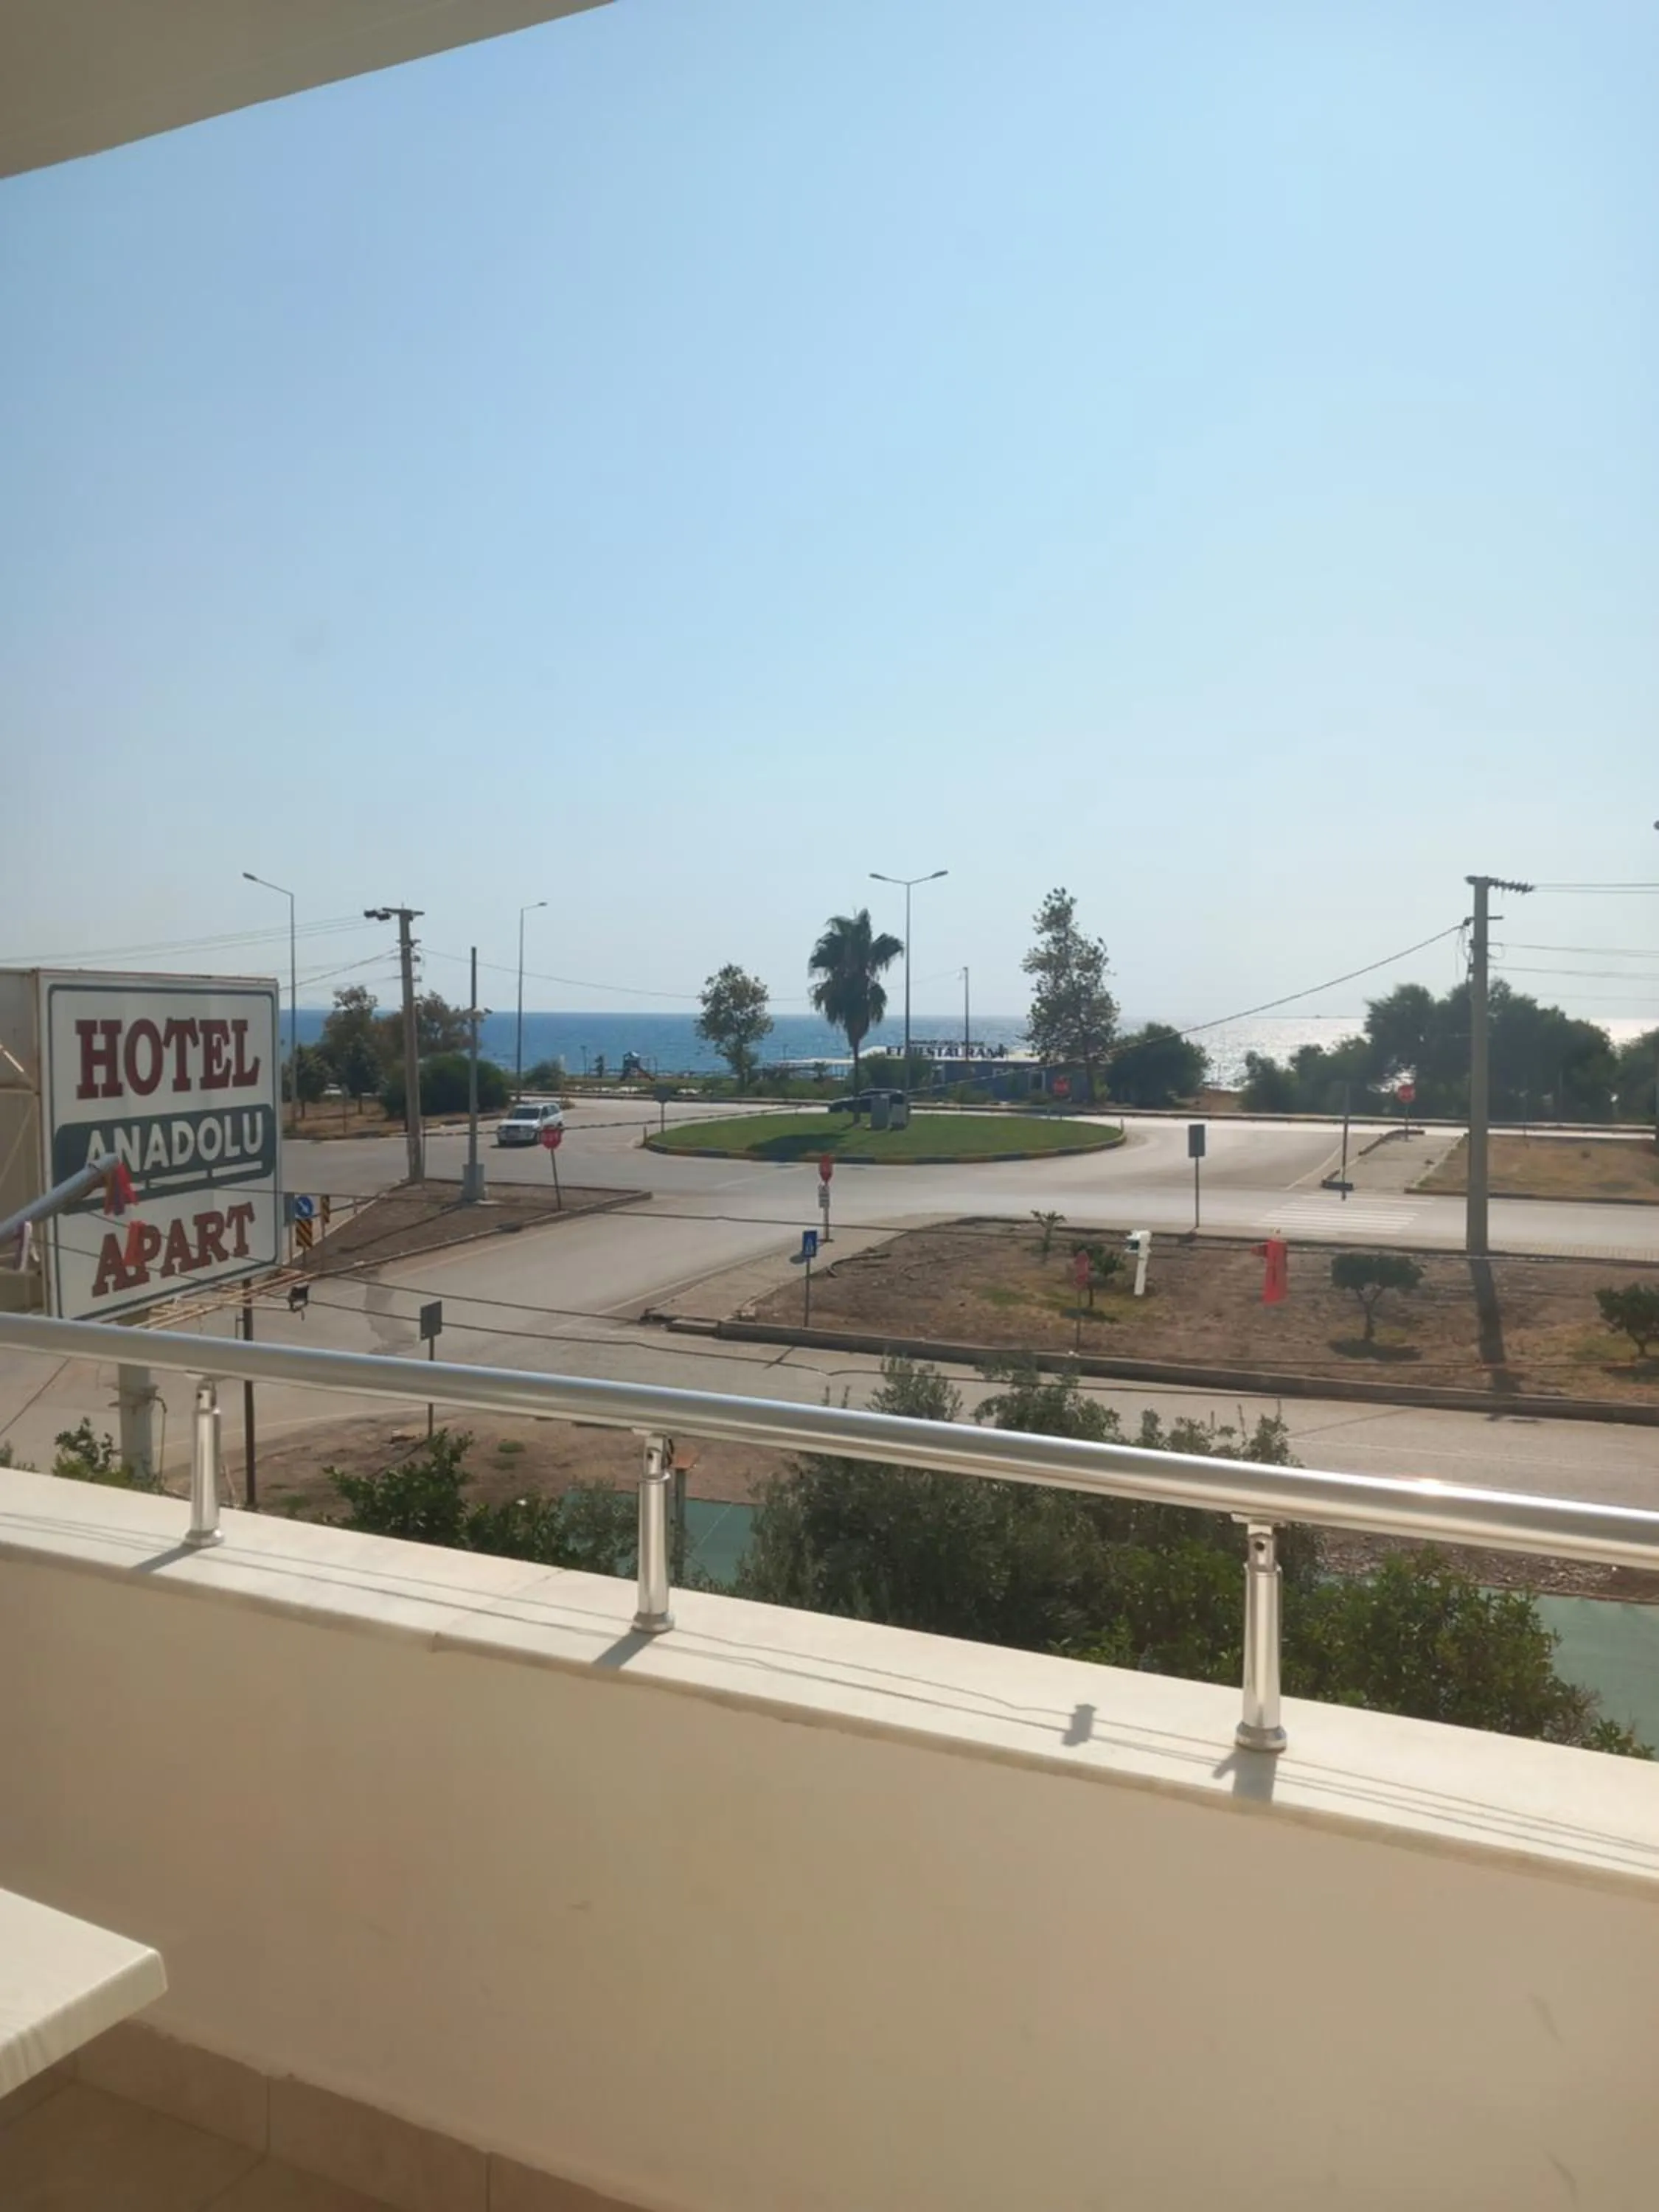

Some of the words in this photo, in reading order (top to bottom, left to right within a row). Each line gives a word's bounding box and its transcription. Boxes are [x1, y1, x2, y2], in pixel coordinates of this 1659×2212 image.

[76, 1017, 261, 1099] HOTEL
[85, 1110, 264, 1173] ANADOLU
[91, 1201, 256, 1298] APART
